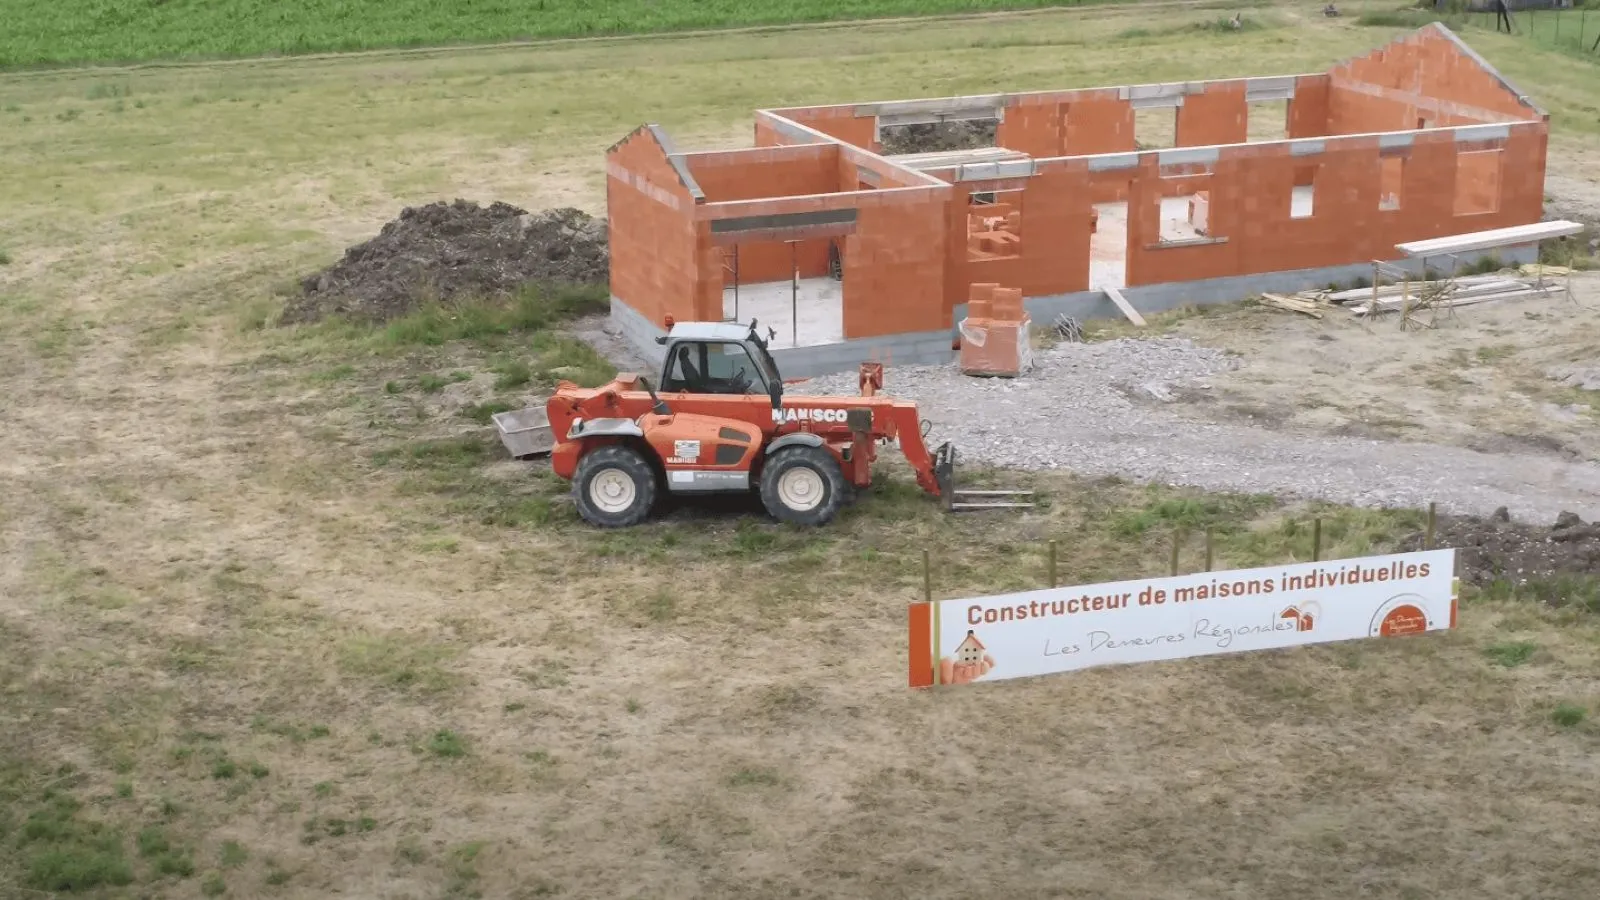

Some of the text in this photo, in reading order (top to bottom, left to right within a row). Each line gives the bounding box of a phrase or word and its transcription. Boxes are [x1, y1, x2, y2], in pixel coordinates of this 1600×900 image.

[967, 560, 1431, 625] Constructeur de maisons individuelles
[1044, 612, 1294, 657] Les Demeures Régionales
